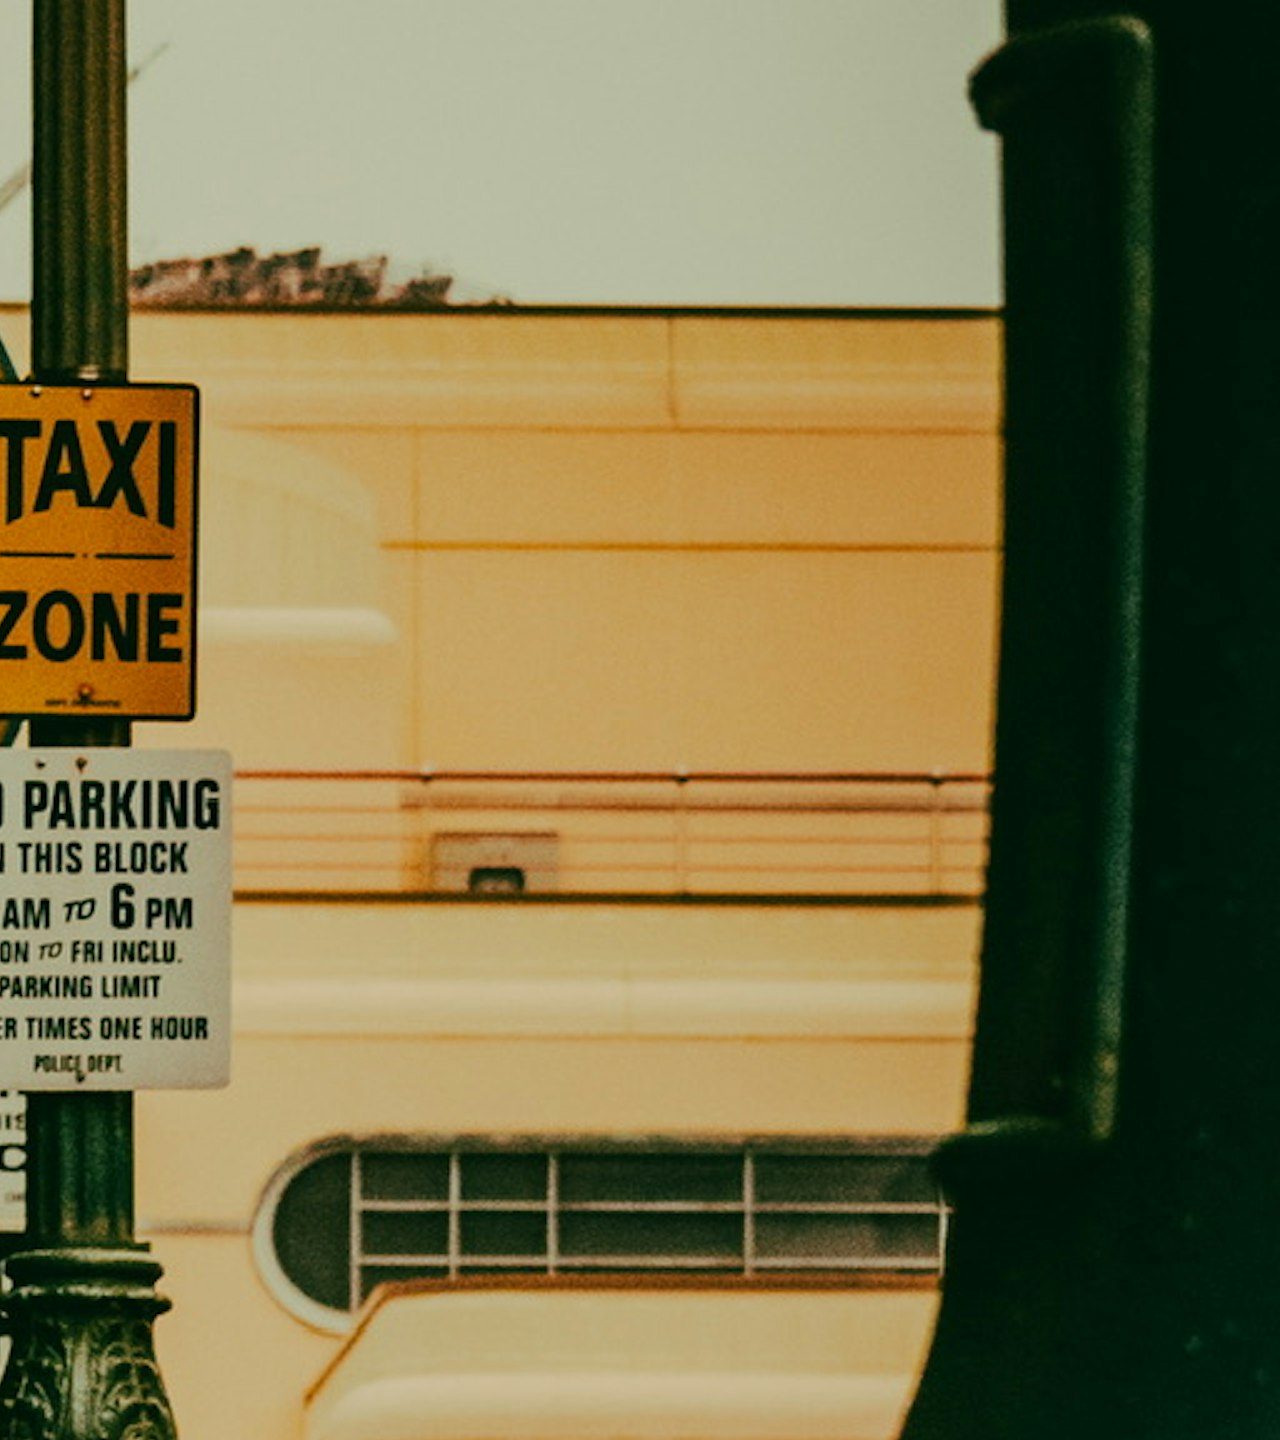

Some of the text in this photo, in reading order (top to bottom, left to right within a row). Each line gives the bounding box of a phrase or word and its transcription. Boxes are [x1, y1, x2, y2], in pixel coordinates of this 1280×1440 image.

[24, 778, 220, 831] PARKING
[17, 841, 83, 874] THIS
[95, 841, 188, 874] BLOCK
[2, 897, 51, 930] AM
[63, 897, 96, 923] TO
[110, 882, 135, 930] 6
[145, 897, 193, 930] PM
[39, 941, 63, 960] TO
[71, 940, 103, 963] FRI
[112, 940, 182, 964] INCLU.
[101, 975, 161, 999] LIMIT
[25, 1016, 92, 1041] TIMES
[100, 1016, 142, 1040] ONE
[150, 1016, 208, 1041] HOUR
[33, 1054, 81, 1073] POLICE
